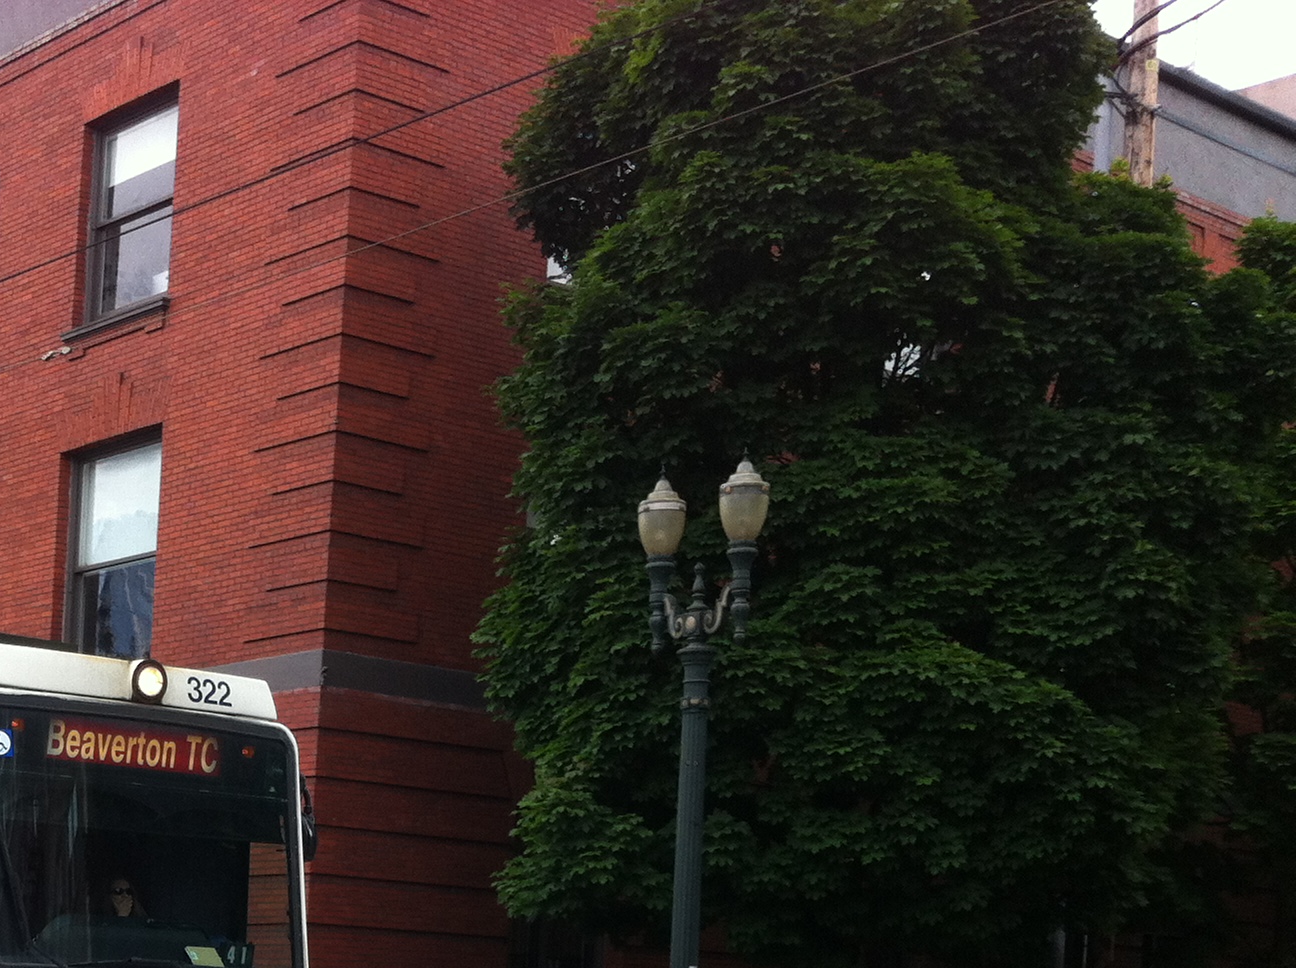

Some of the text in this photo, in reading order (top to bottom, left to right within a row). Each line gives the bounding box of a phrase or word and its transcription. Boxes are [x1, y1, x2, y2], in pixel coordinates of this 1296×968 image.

[187, 676, 233, 707] 322
[47, 719, 219, 773] Beaverton TC
